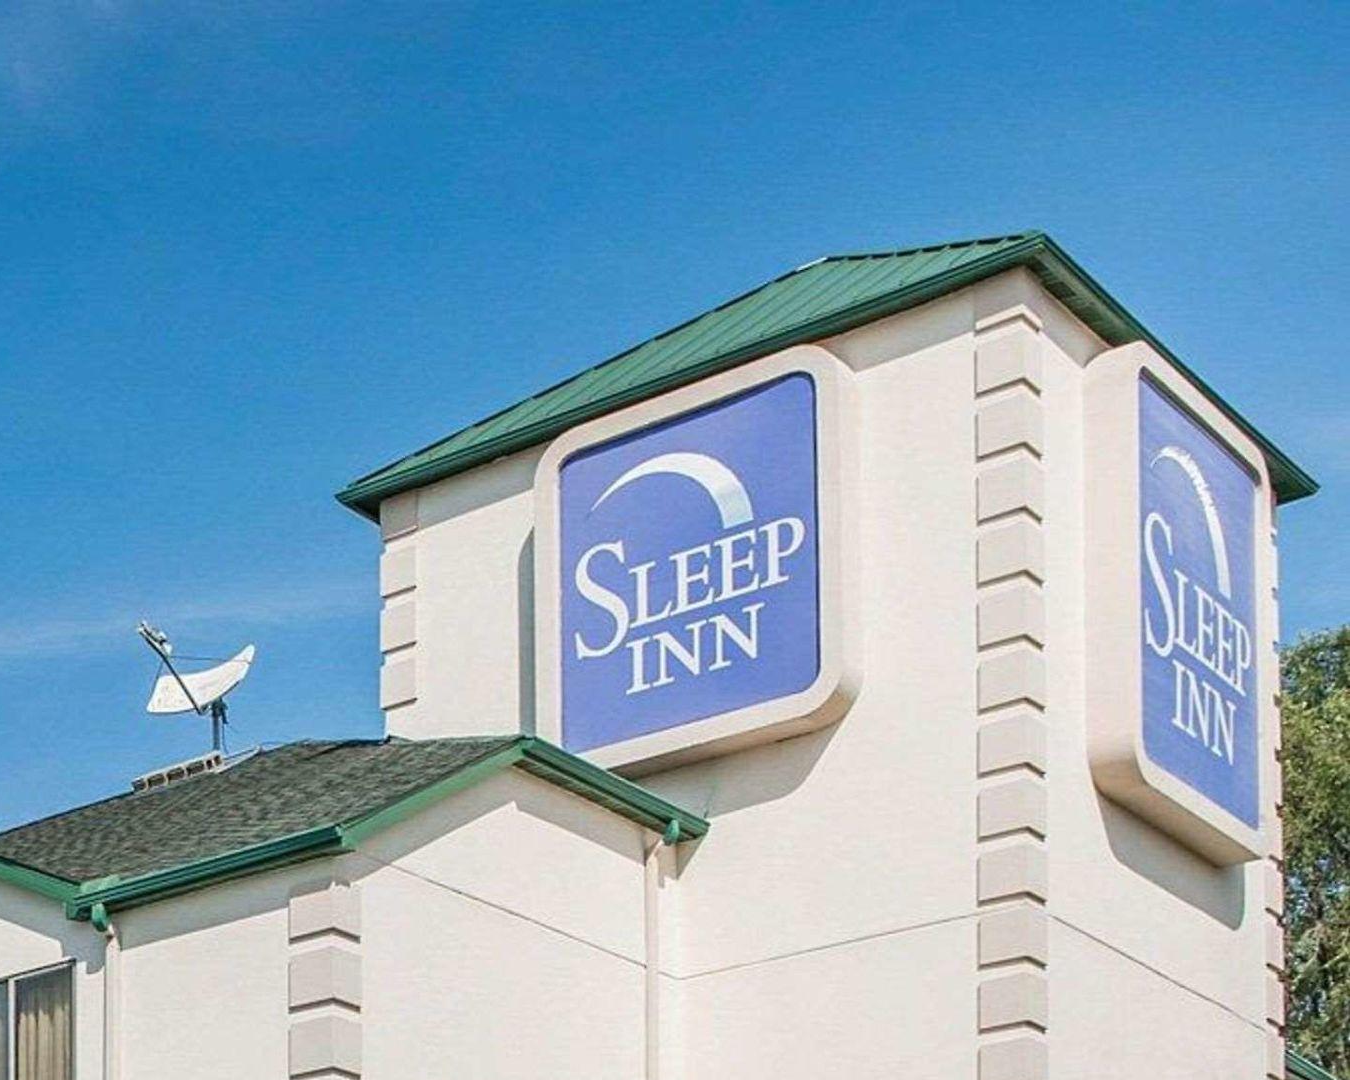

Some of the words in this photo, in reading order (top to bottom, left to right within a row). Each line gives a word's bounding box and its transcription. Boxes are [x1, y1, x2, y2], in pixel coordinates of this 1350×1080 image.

[575, 516, 805, 659] SLEEP
[626, 603, 765, 695] INN
[1144, 512, 1250, 696] SLEEP
[1172, 659, 1236, 766] INN
